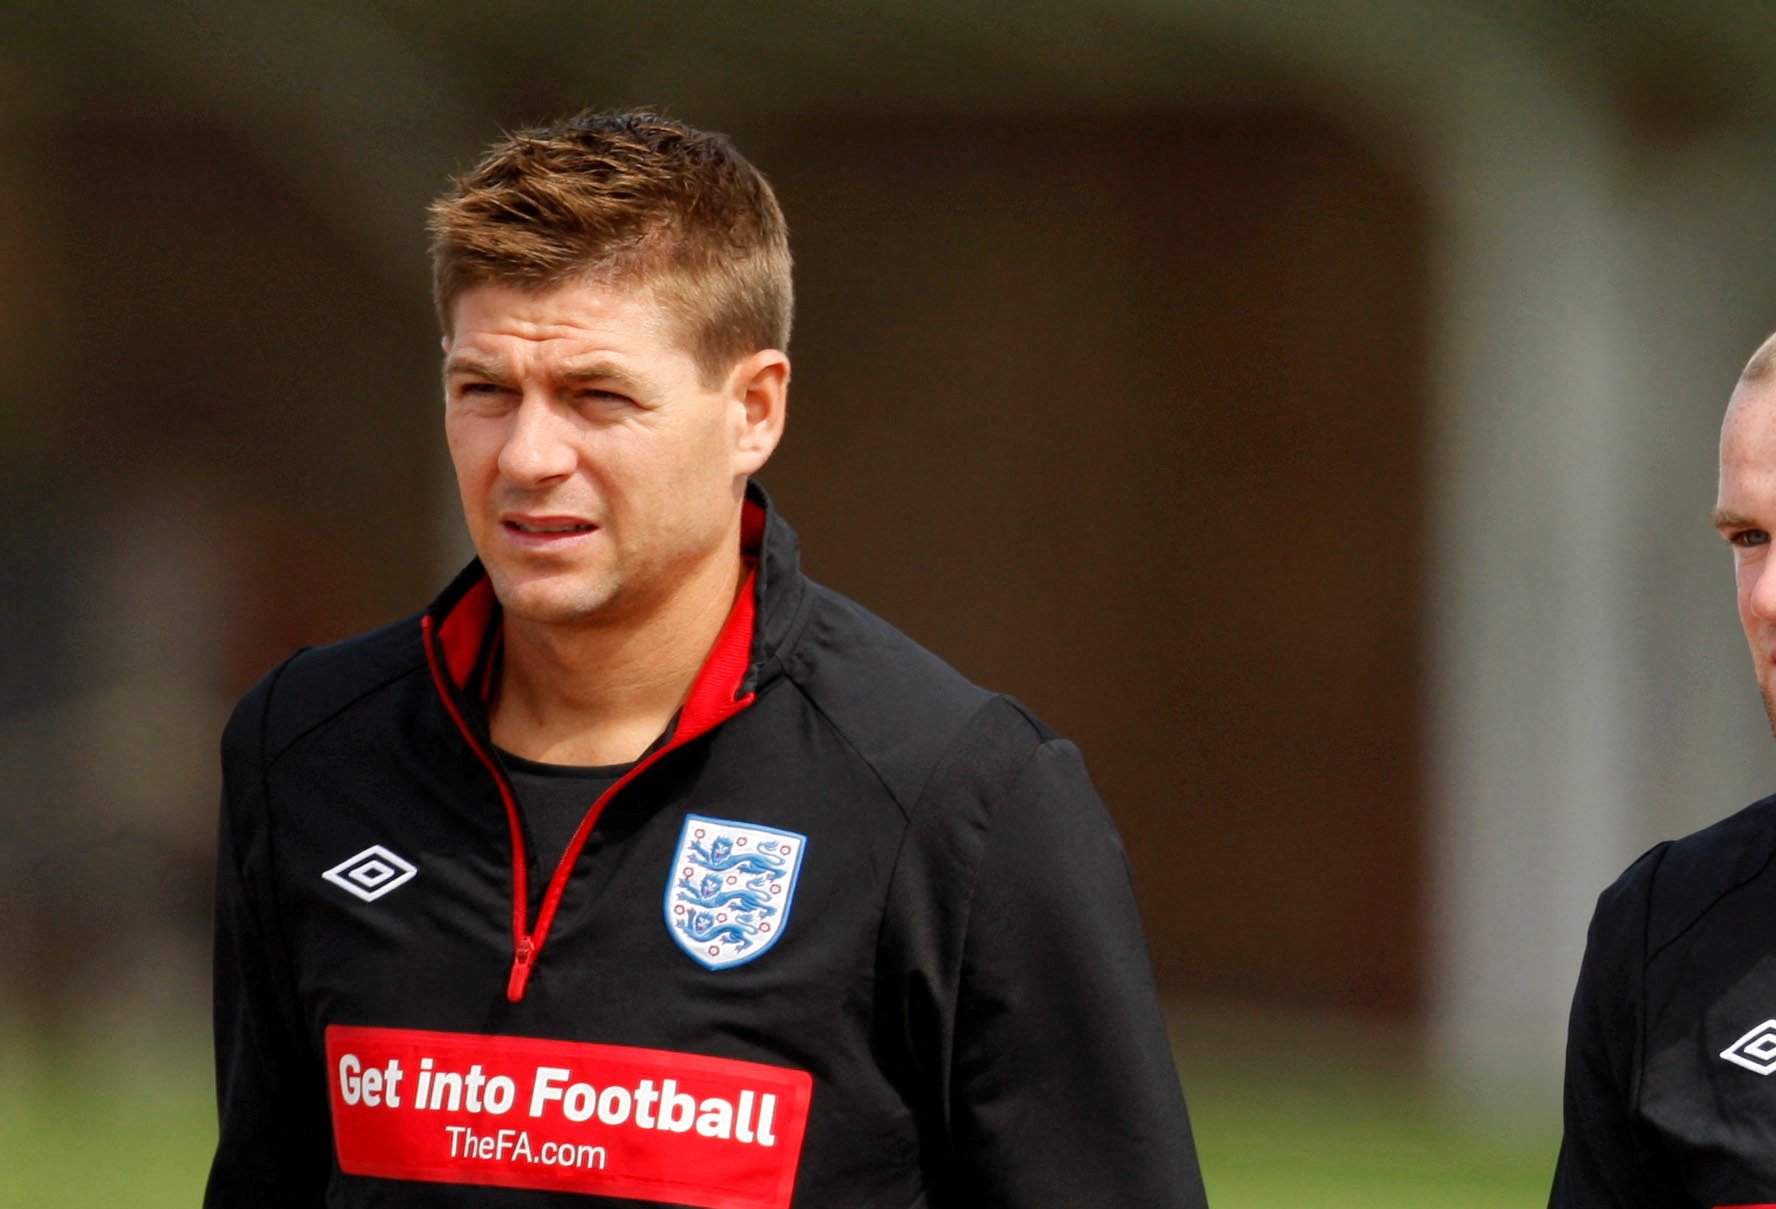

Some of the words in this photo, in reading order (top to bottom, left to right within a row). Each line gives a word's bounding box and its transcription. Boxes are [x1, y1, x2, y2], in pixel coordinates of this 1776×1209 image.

[338, 1053, 404, 1108] Get
[414, 1057, 516, 1116] into
[528, 1065, 777, 1147] Football
[445, 1125, 606, 1170] TheFA.com
